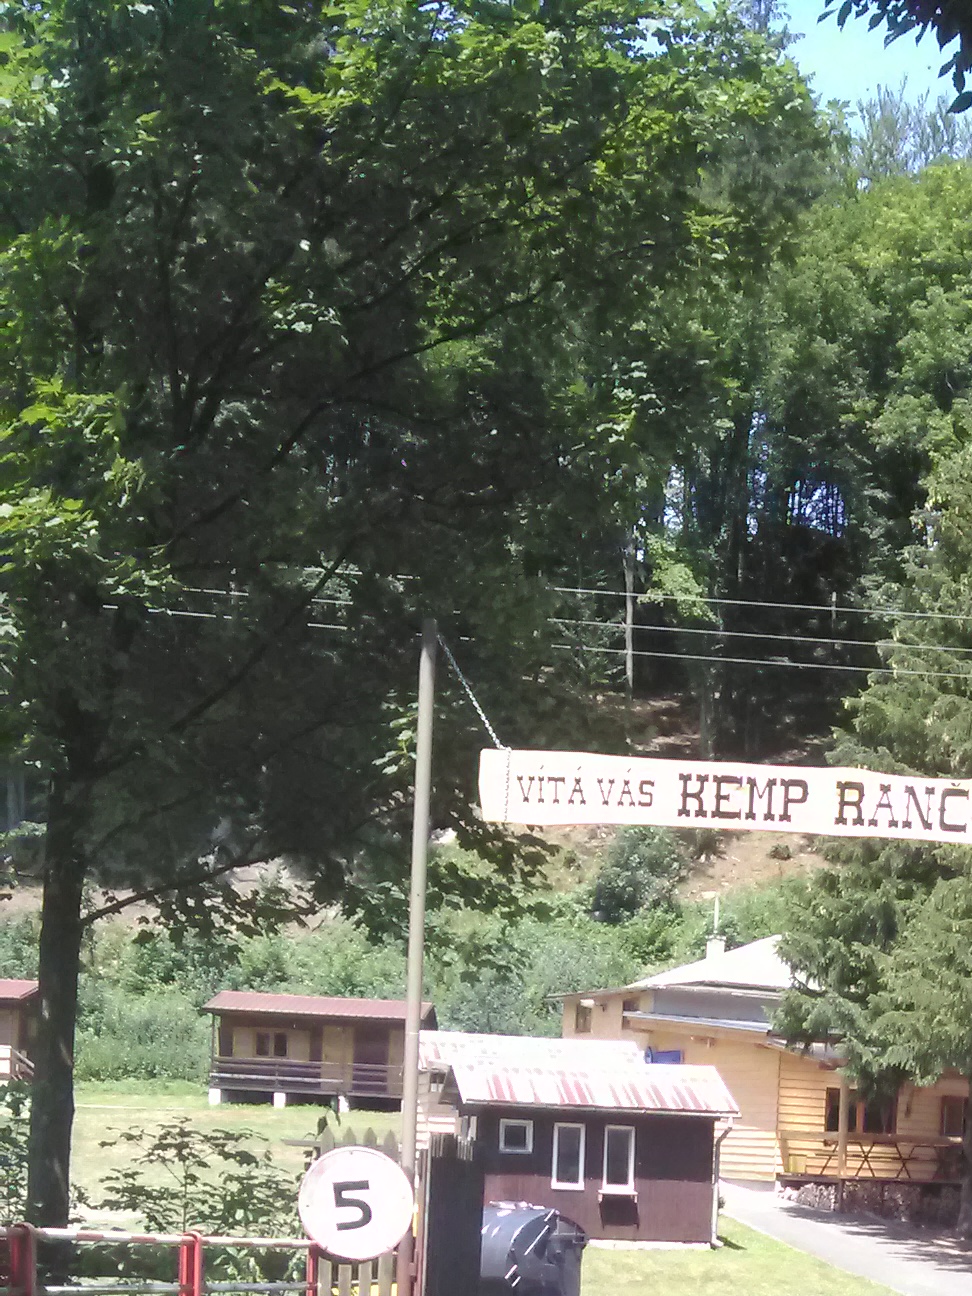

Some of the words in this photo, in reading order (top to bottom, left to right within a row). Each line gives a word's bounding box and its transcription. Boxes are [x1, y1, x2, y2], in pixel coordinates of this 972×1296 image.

[517, 764, 586, 806] VÍTÁ
[597, 767, 656, 808] VÁS
[677, 773, 809, 823] KEMP
[834, 781, 970, 833] RANČ
[332, 1180, 373, 1232] 5
